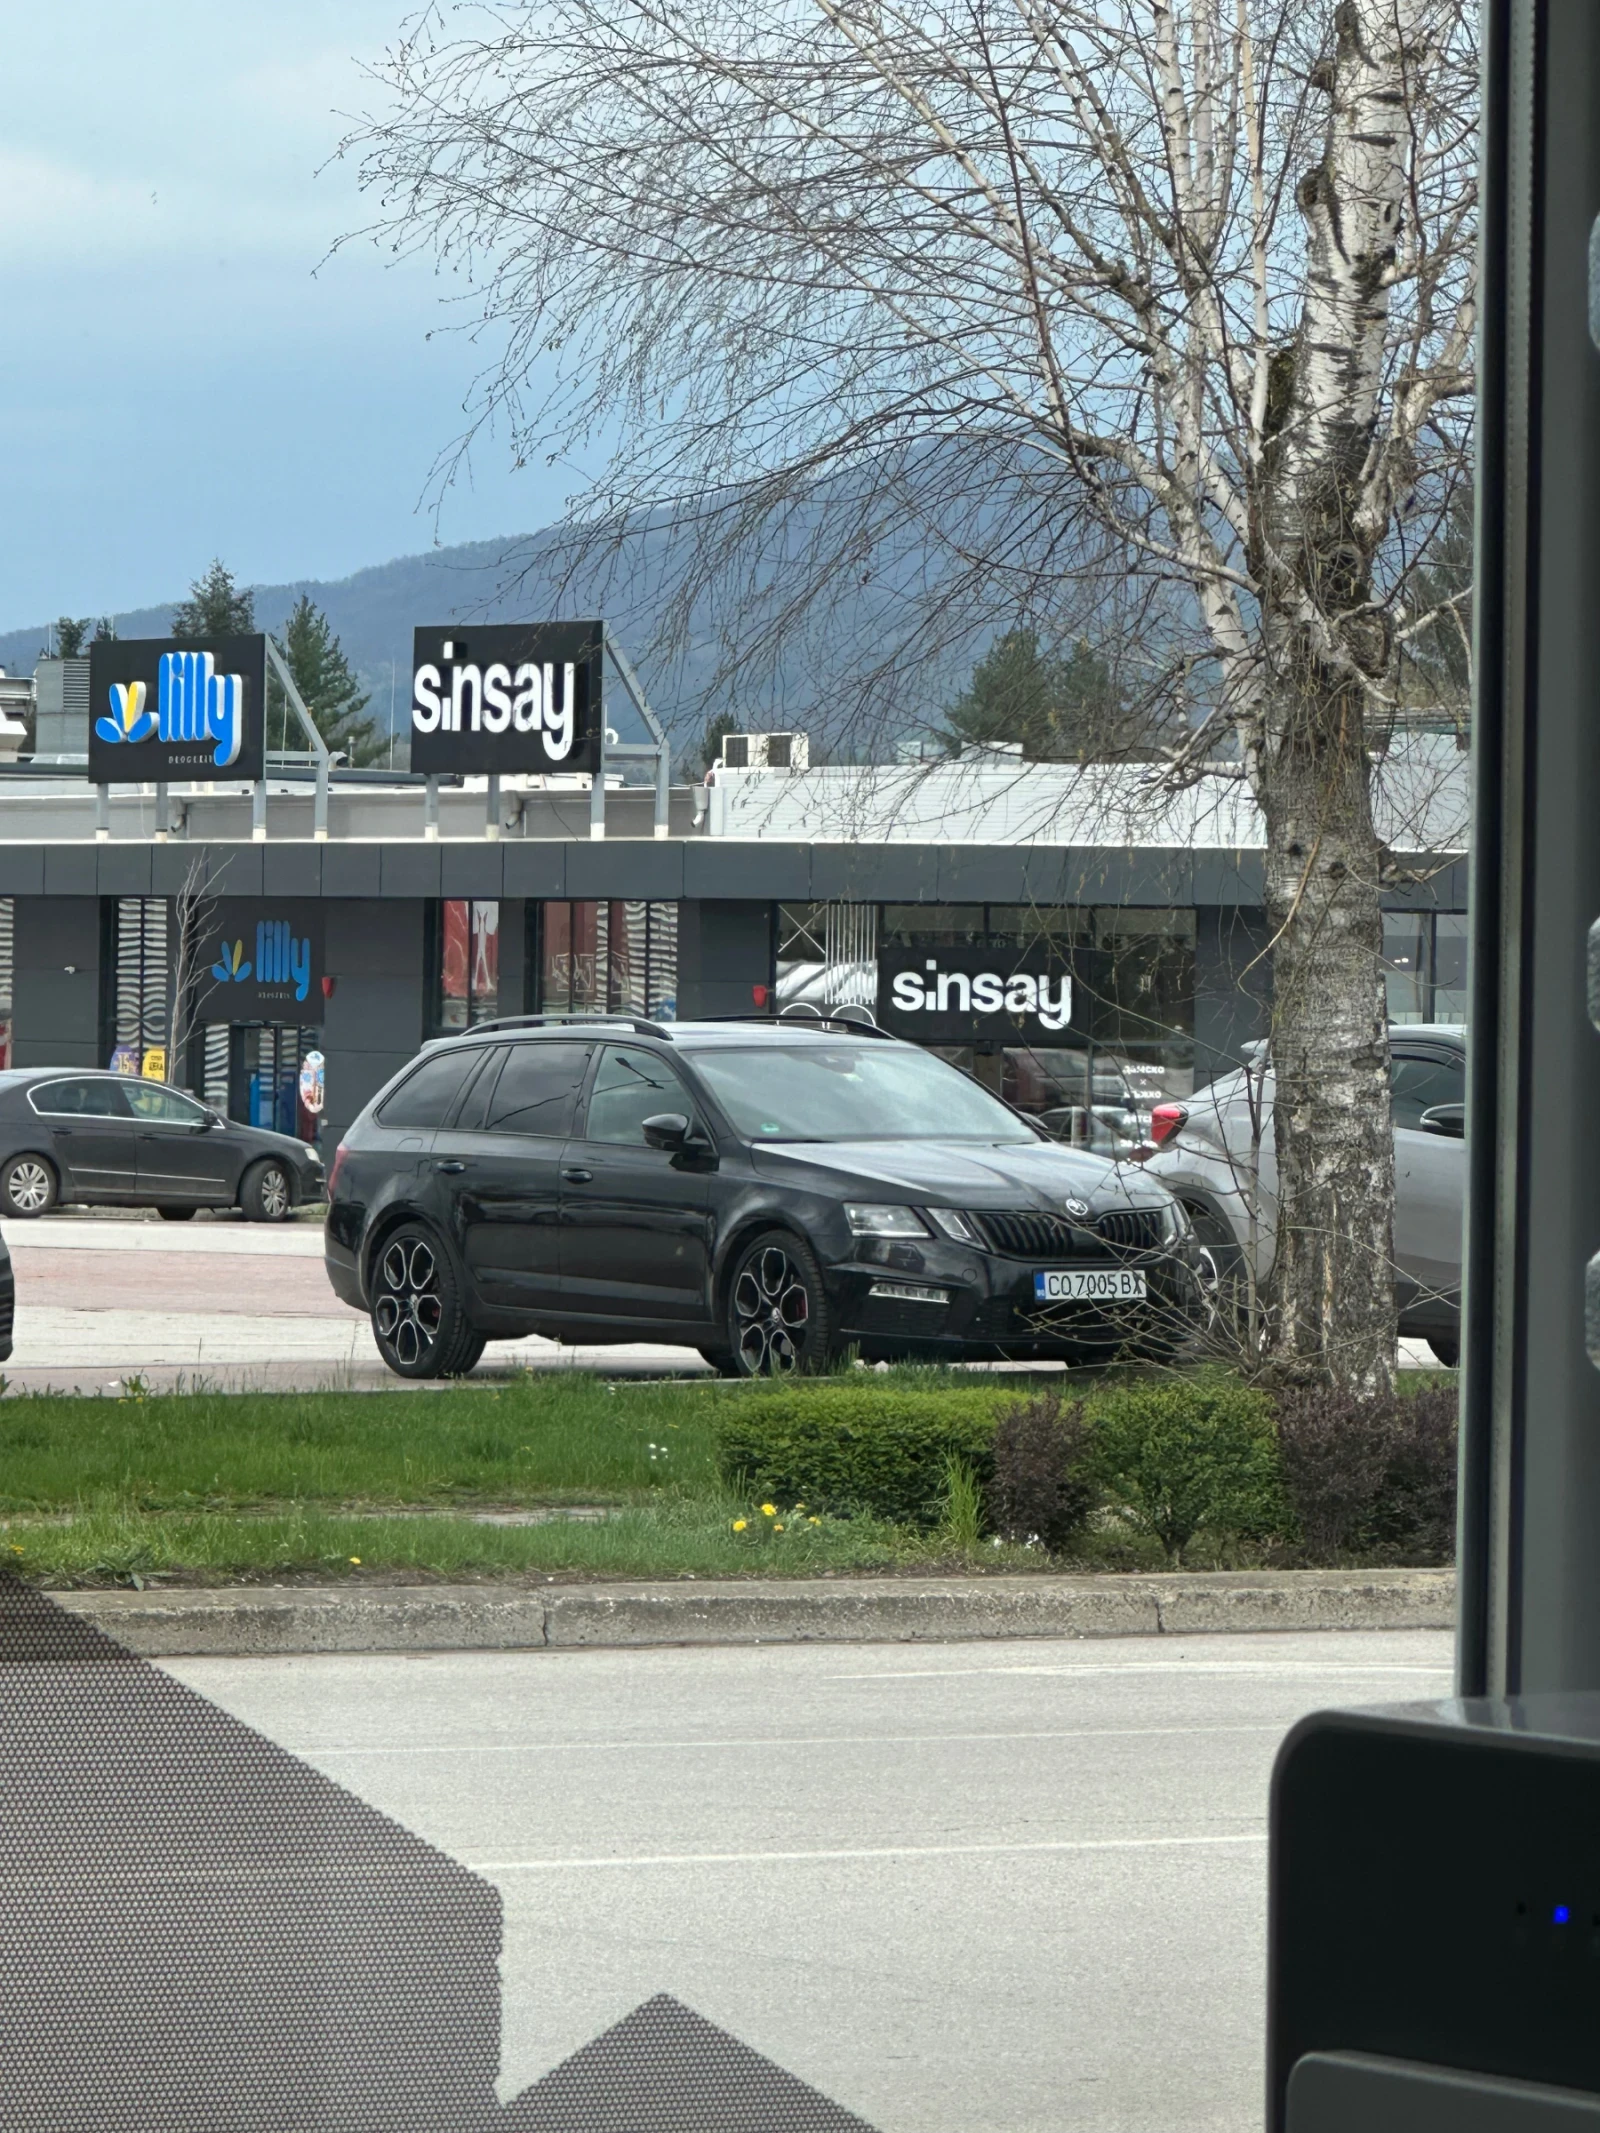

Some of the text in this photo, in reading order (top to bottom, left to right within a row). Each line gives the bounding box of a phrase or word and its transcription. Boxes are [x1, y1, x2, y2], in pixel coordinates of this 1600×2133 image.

[158, 651, 243, 767] lilly
[412, 641, 574, 761] sinsay
[256, 920, 311, 1002] lilly
[891, 959, 1072, 1030] sinsay
[1075, 1274, 1118, 1296] 7005
